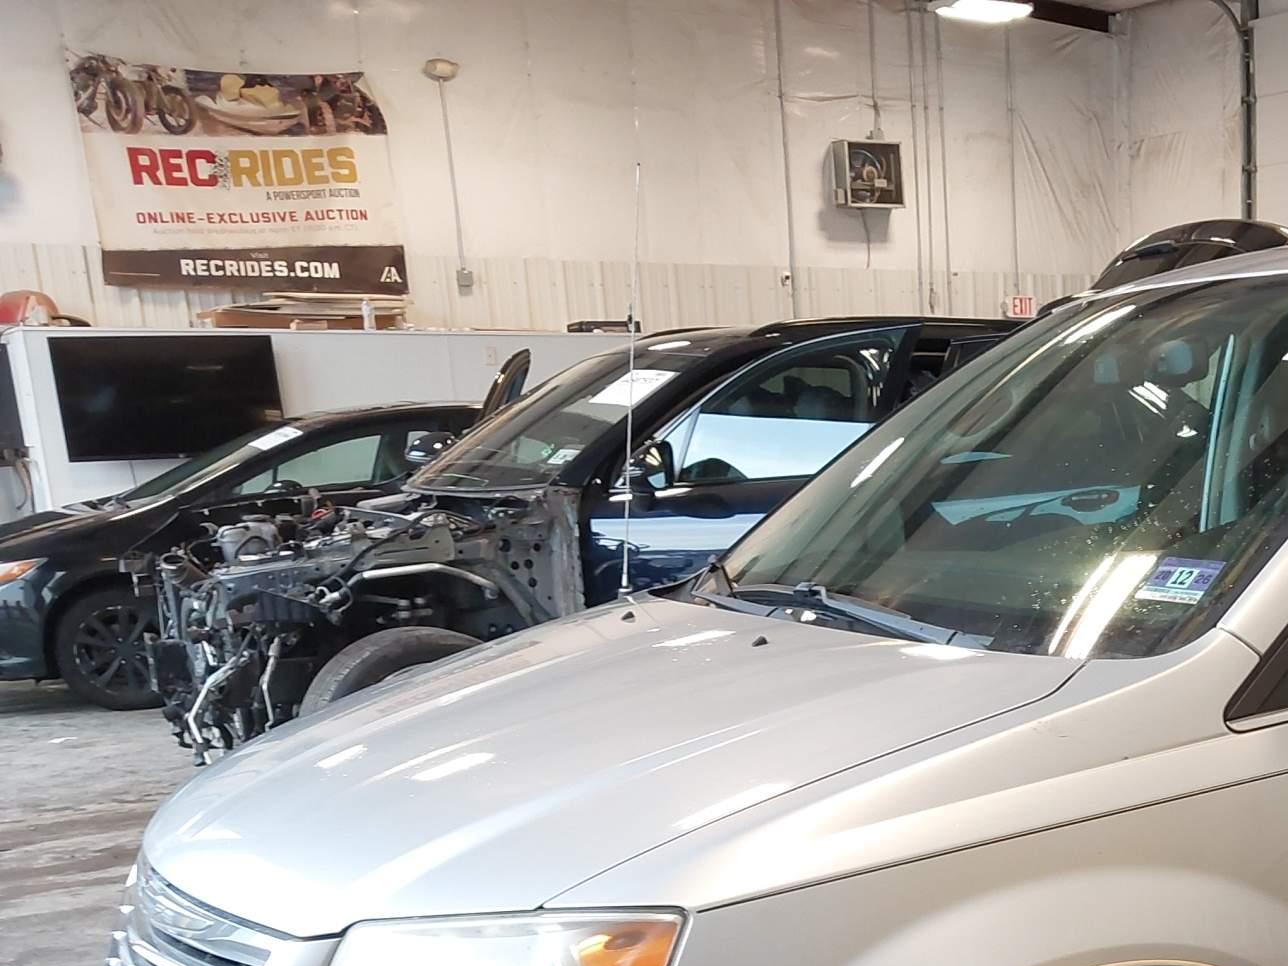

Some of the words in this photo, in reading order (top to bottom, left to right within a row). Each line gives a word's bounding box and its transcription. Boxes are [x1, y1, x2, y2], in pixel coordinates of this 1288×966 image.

[126, 147, 219, 187] REC
[228, 146, 358, 188] RIDES
[273, 189, 327, 201] POWERSPORT
[328, 187, 360, 198] AUCTION
[136, 211, 299, 225] ONLINE-EXCLUSIVE
[304, 208, 369, 222] AUCTION
[180, 258, 341, 279] RECRIDES.COM
[1012, 296, 1033, 315] EXIT
[1170, 569, 1195, 586] 12
[1193, 573, 1213, 585] 26
